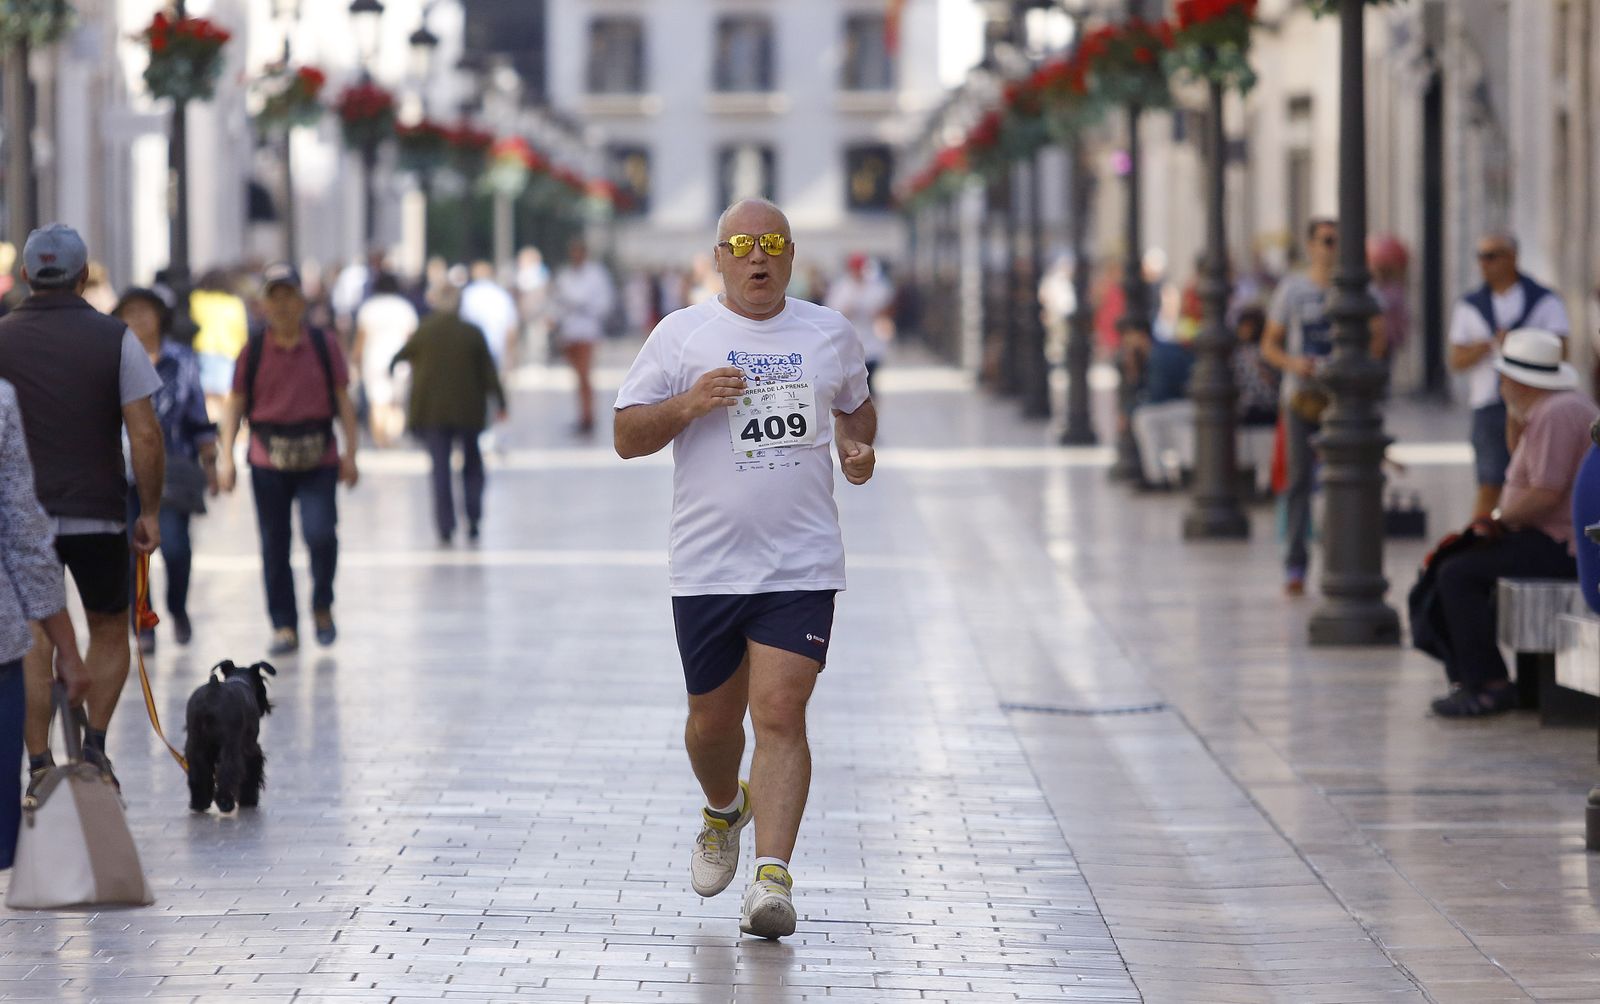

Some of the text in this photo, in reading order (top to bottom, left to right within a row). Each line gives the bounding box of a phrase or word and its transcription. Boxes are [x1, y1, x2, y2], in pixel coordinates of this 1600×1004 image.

[737, 352, 790, 365] Carrera
[745, 388, 766, 396] RRERA
[740, 413, 808, 443] 409
